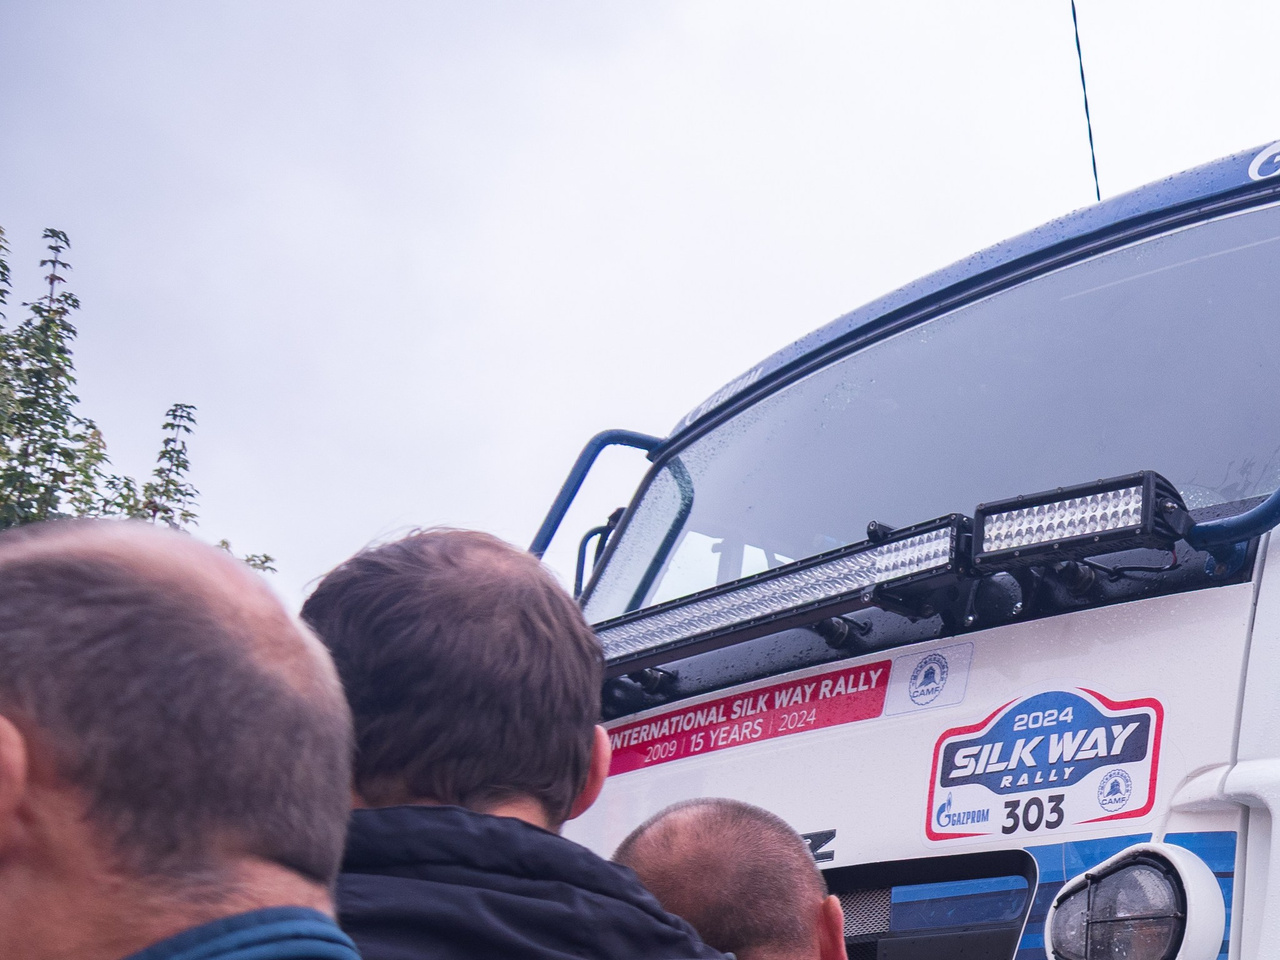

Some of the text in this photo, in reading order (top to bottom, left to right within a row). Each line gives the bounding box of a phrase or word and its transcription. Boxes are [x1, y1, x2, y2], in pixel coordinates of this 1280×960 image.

[912, 686, 940, 698] CAMF
[608, 706, 728, 751] INTERNATIONAL
[730, 693, 768, 720] SILK
[774, 682, 818, 710] WAY
[818, 668, 884, 699] RALLY
[1013, 706, 1074, 732] 2024
[644, 707, 817, 763] 2009 15 YEARS 2024
[948, 721, 1141, 779] SILK WAY
[1000, 766, 1076, 789] RALLY
[1001, 793, 1065, 835] 303
[1101, 796, 1127, 806] CAMF
[951, 808, 990, 827] GAZPROM
